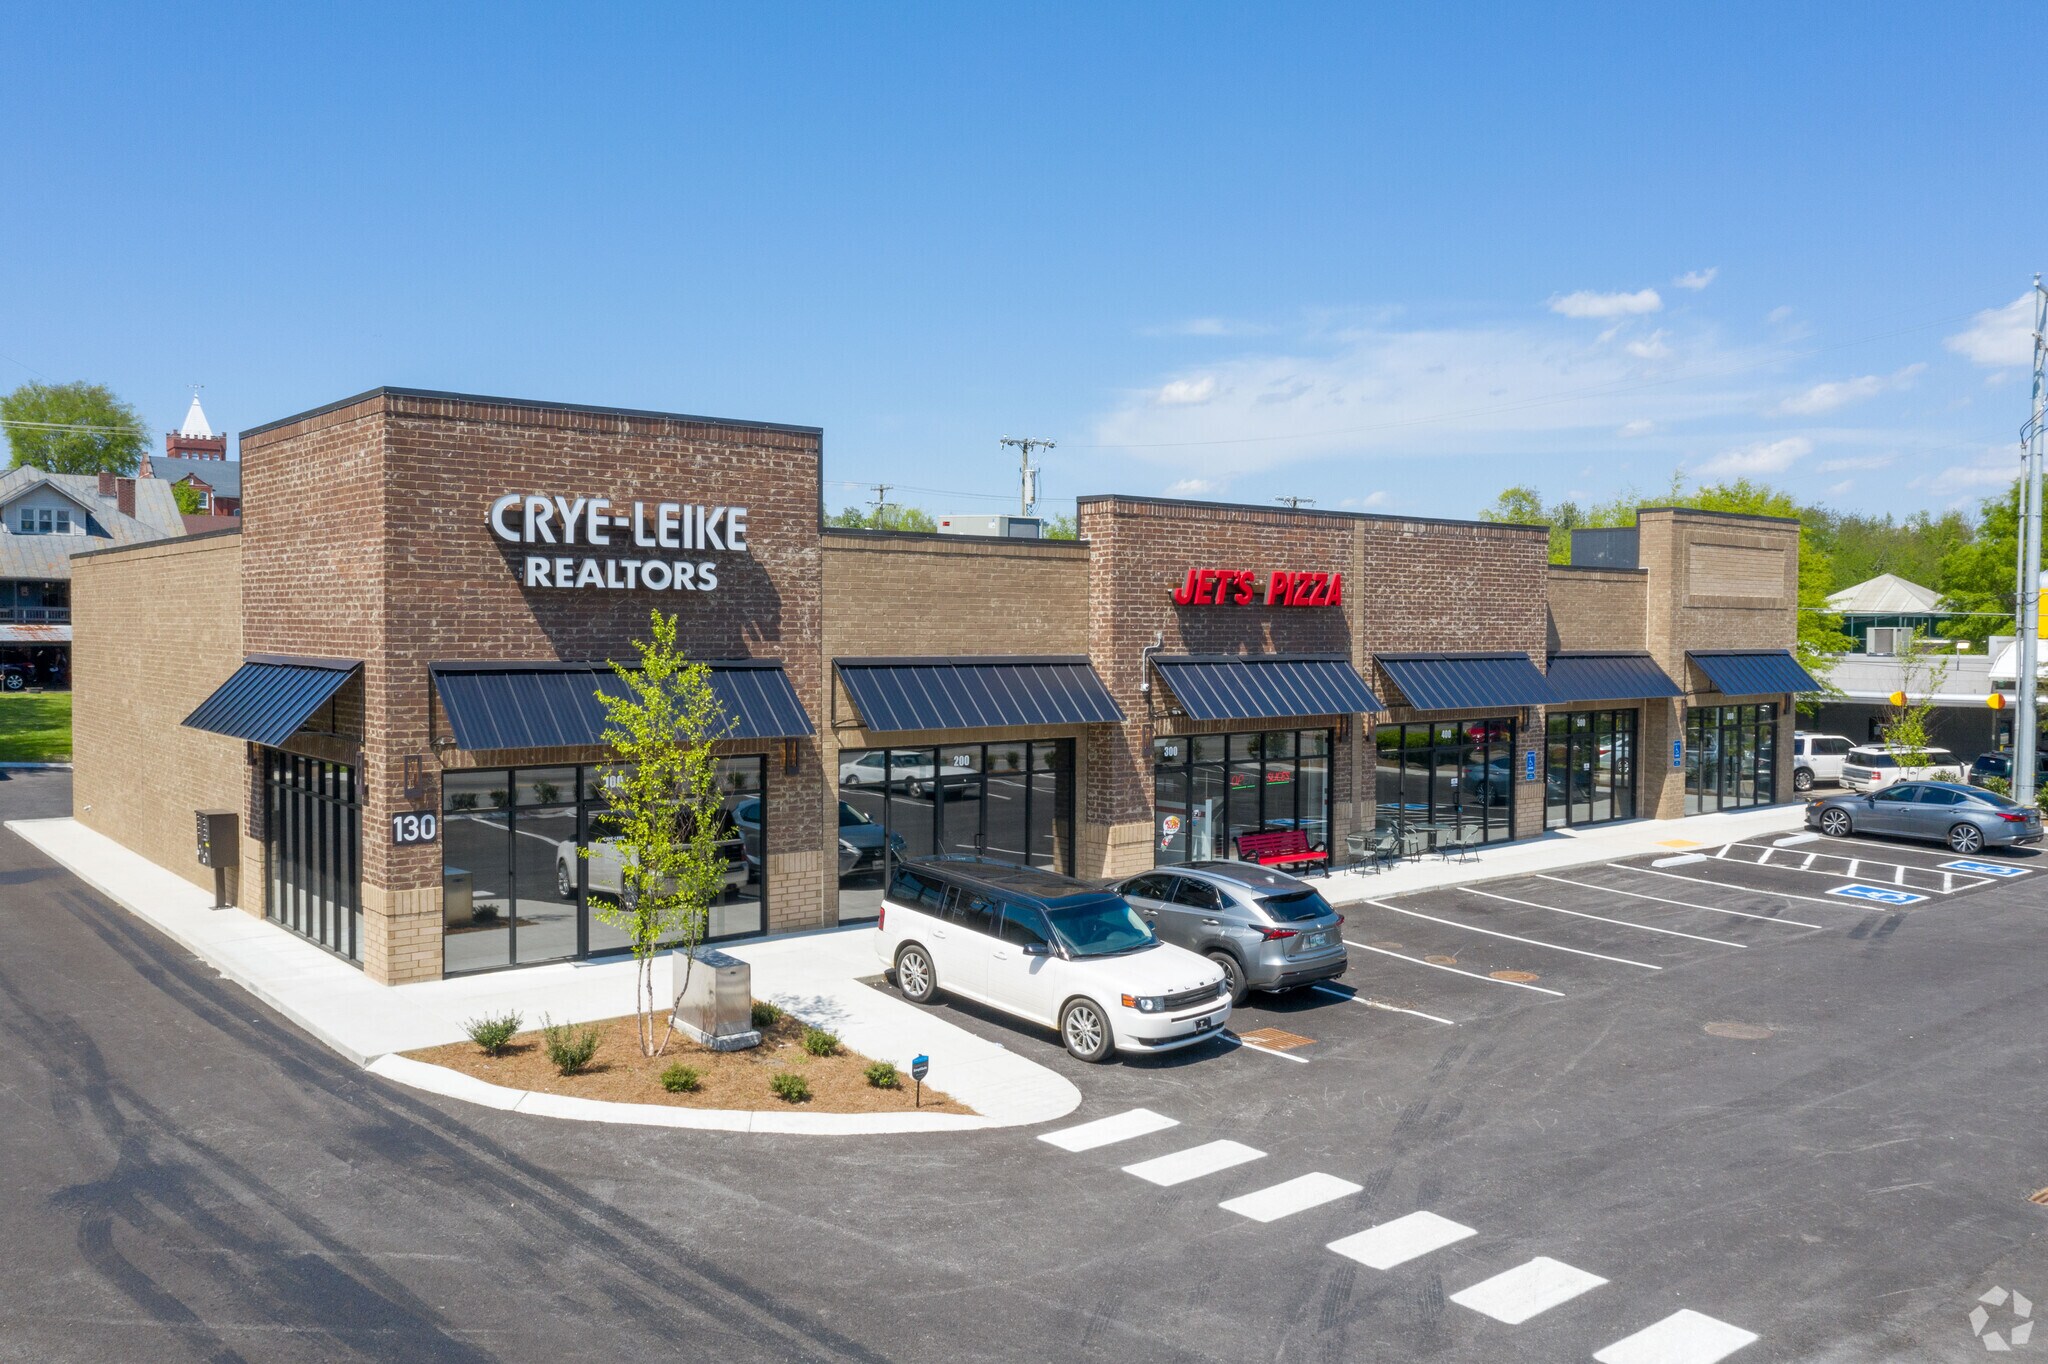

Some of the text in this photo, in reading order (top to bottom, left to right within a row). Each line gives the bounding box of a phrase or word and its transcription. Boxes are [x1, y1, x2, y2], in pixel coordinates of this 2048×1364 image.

[490, 494, 748, 551] CRYE-LEIKE
[524, 556, 718, 591] REALTORS
[1174, 568, 1342, 606] JET'S PIZZA
[953, 755, 970, 767] 200
[1164, 746, 1178, 757] 300
[393, 814, 436, 842] 130
